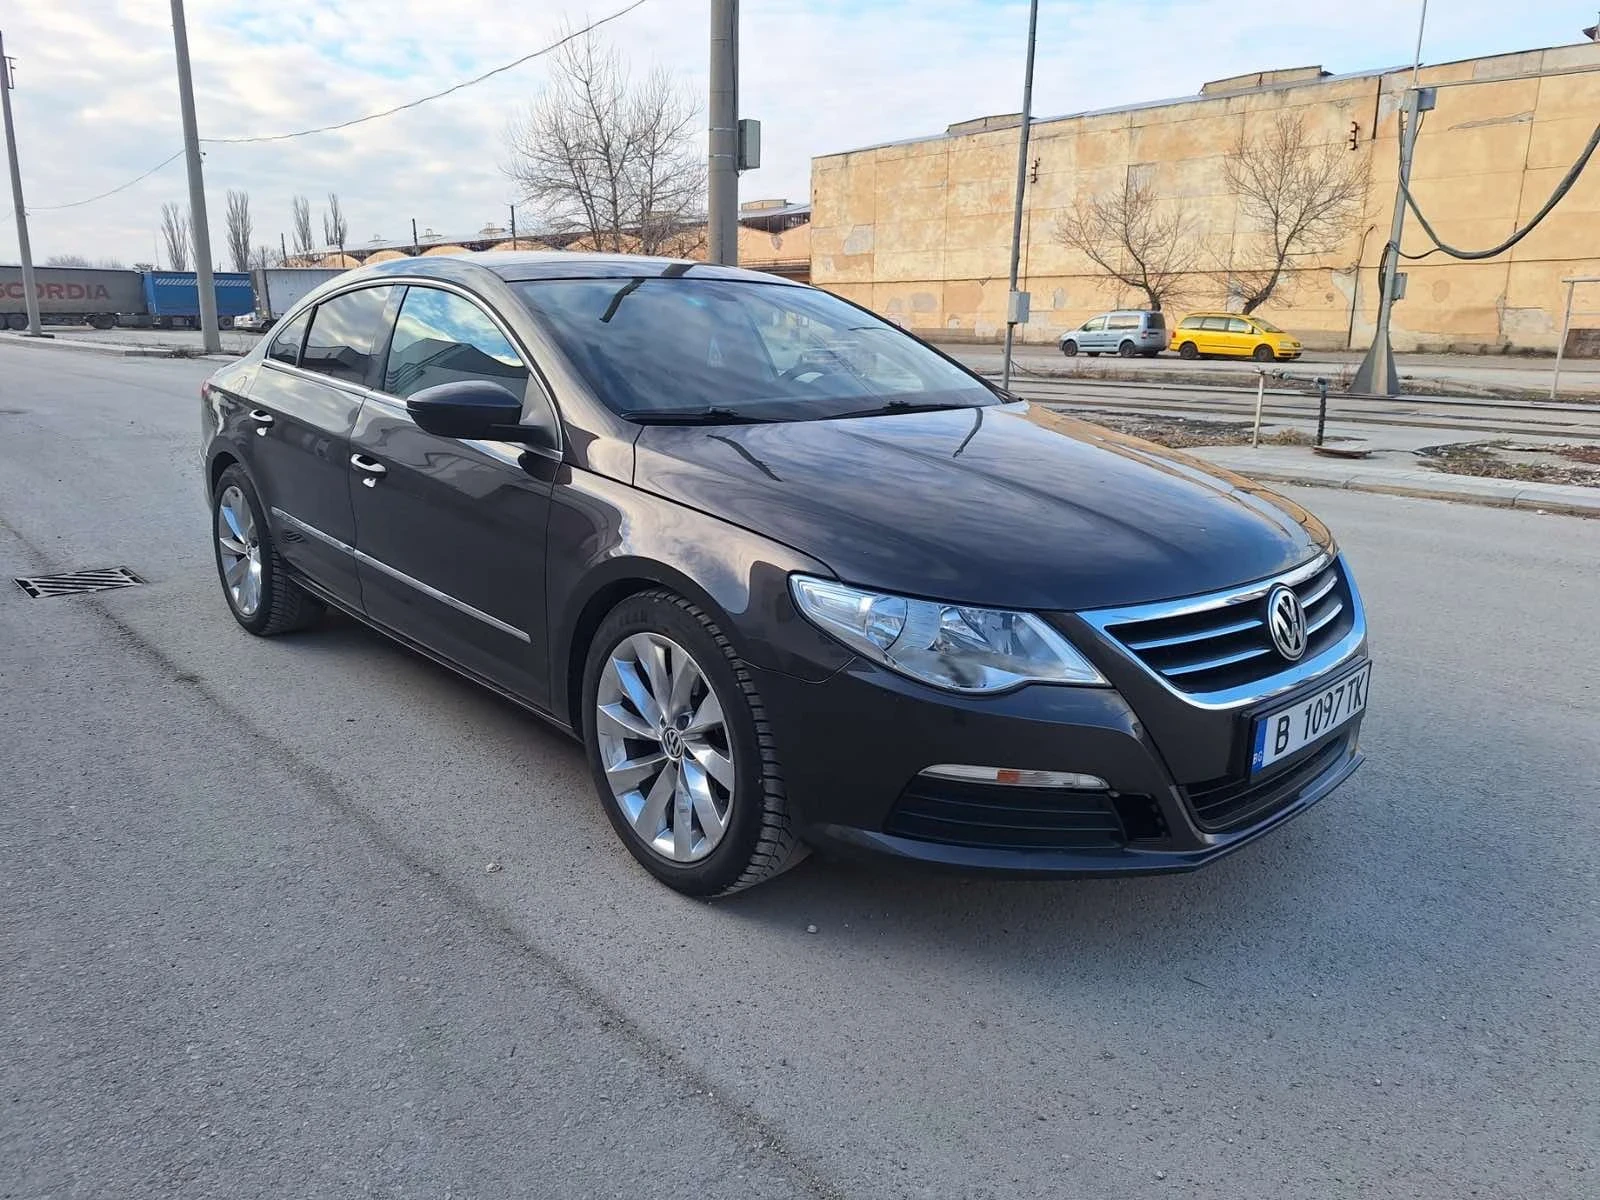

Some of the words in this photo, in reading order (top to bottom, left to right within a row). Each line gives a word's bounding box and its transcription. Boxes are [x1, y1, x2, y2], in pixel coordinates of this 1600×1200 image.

[1274, 714, 1290, 755] B
[1304, 685, 1345, 740] 1097
[1347, 671, 1366, 714] TK
